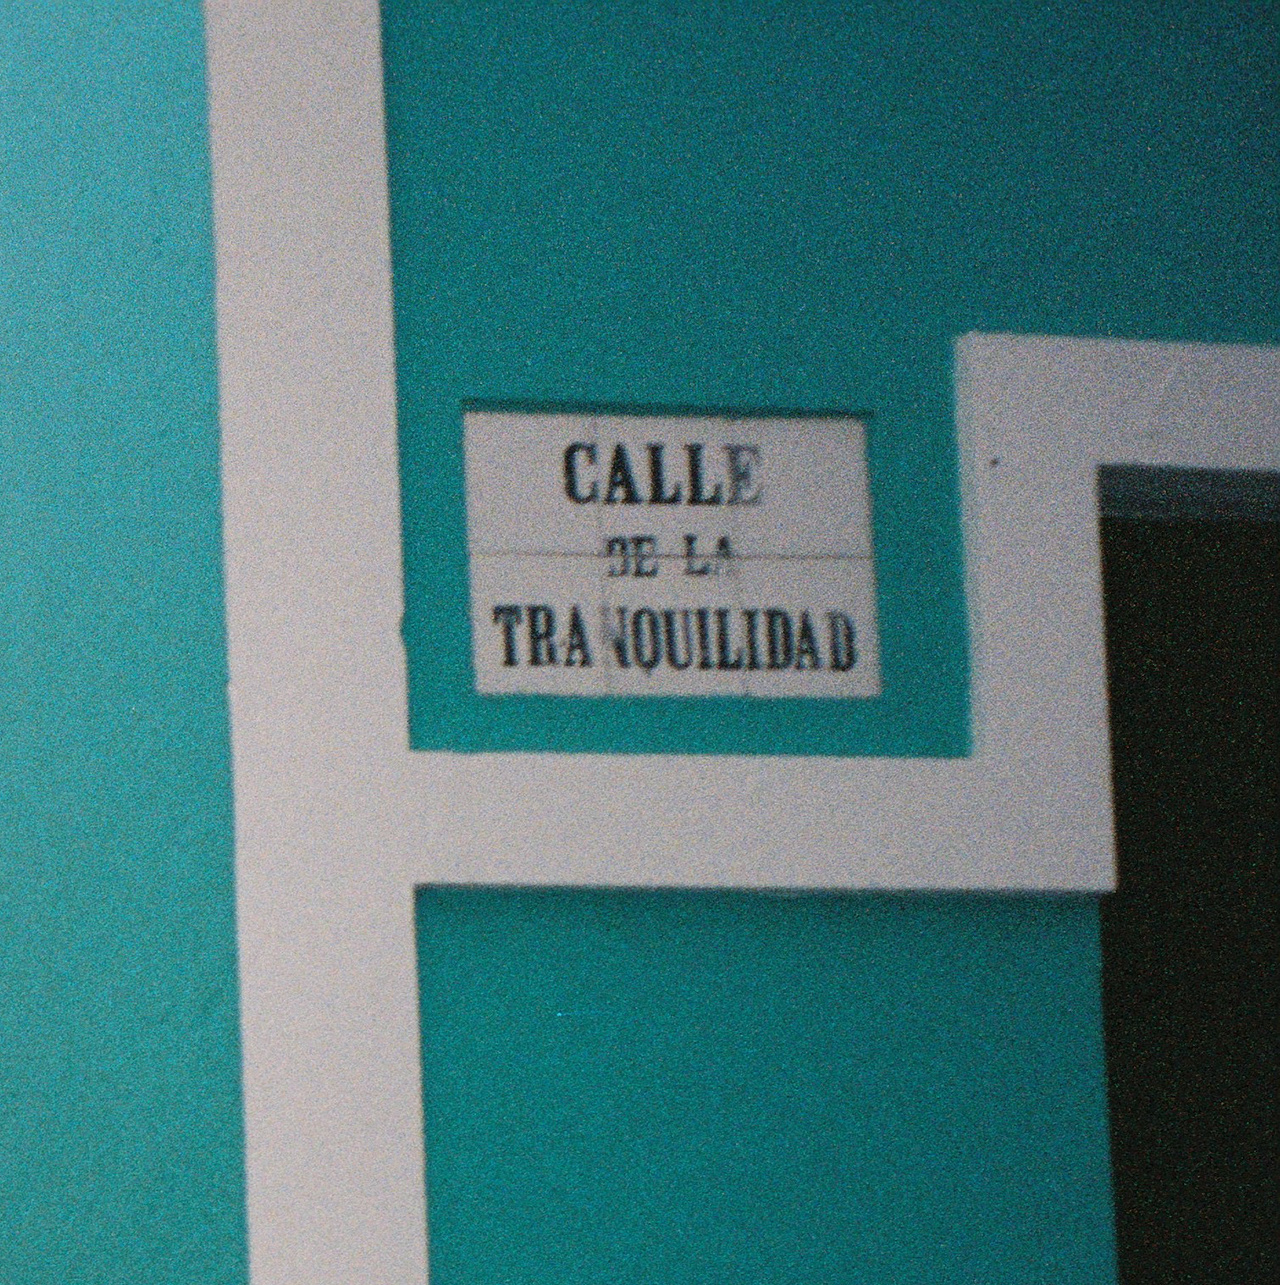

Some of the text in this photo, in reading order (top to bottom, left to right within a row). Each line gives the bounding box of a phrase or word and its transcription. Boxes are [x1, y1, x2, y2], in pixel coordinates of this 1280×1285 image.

[562, 441, 762, 506] CALLE
[683, 533, 736, 577] LA
[492, 604, 858, 676] TRANQUILIDAD
